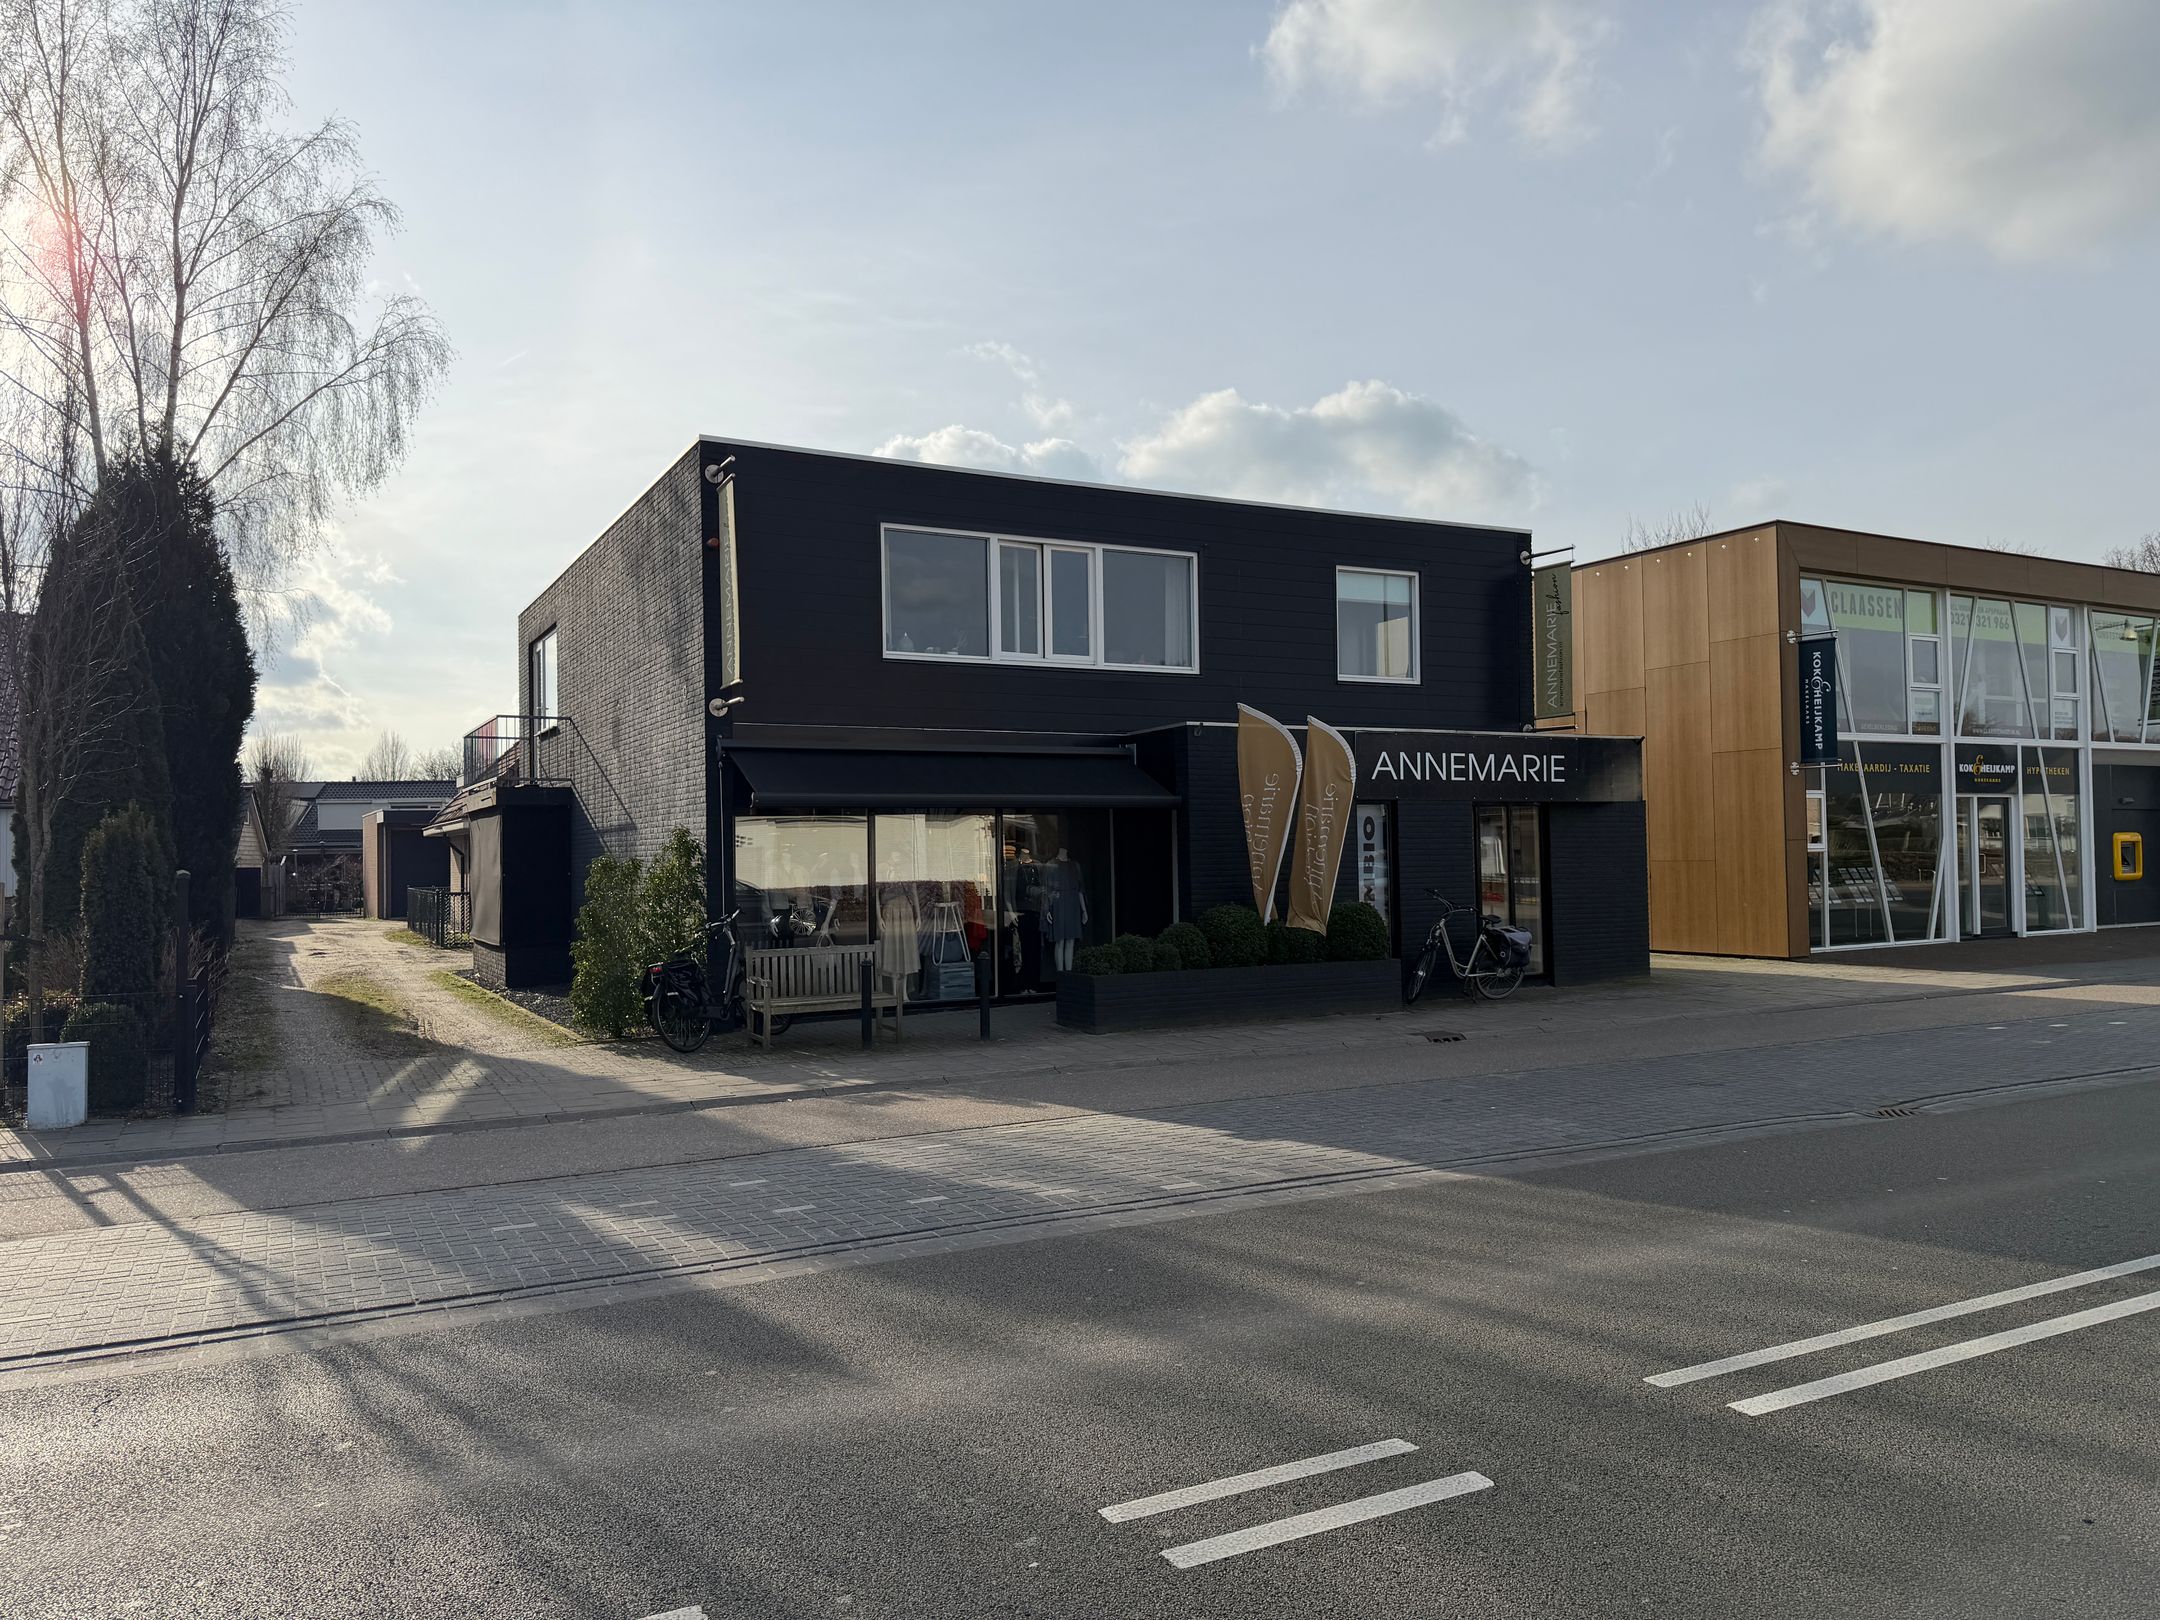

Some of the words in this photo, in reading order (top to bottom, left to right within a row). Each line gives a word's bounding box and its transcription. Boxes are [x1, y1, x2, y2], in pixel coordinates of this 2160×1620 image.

[1545, 573, 1570, 616] fashion
[1831, 590, 1902, 620] CLAASSEN
[1994, 616, 2010, 630] 966
[1546, 602, 1558, 708] ANNEMARIE
[1371, 751, 1566, 783] ANNEMARIE
[1837, 763, 1892, 773] MAKEAARDIJ
[1900, 763, 1930, 773] TAXATIE
[2026, 766, 2070, 776] HYPTHEKEN
